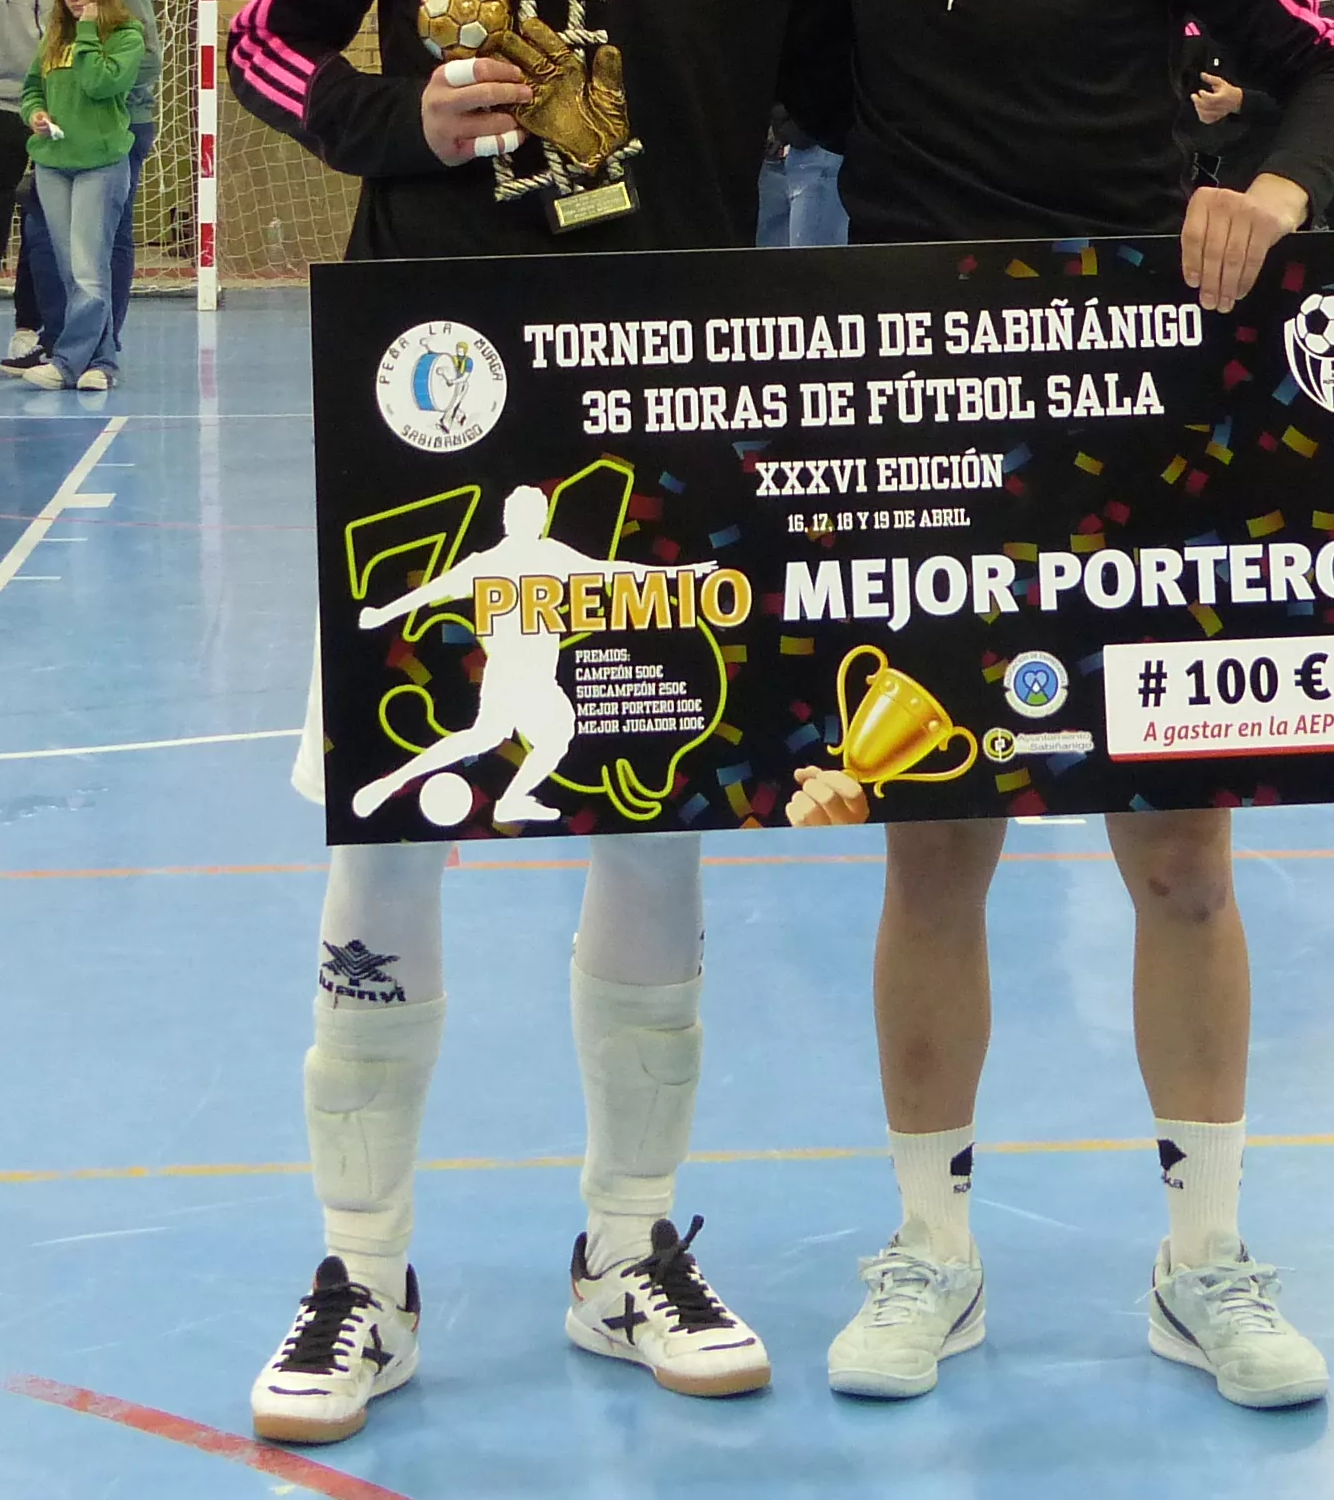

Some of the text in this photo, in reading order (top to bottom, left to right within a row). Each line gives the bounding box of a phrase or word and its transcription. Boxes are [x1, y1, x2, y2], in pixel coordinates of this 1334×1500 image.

[523, 297, 1203, 369] TORNEO CIUDAD DE SABIÑÁNIGO
[429, 323, 452, 335] LA
[474, 338, 504, 381] MURGA
[582, 370, 1165, 435] 36 HORAS DE FÚTBOL SALA
[755, 447, 1004, 497] XXXVI EDICIÓN
[788, 507, 971, 534] 16, 17, 18 Y 19 DE ABRIL
[473, 568, 752, 636] PREMIO
[783, 554, 1020, 632] MEJOR
[575, 649, 631, 663] PREMIOS:
[576, 664, 664, 681] CAMPEÓN 500€
[1138, 660, 1167, 708] #
[1185, 656, 1279, 706] 100
[1294, 652, 1332, 701] €
[576, 681, 687, 698] SUBCAMPEÓN 250€
[577, 699, 703, 716] MEJOR PORTERO 100€
[578, 716, 705, 734] MEJOR JUGADOR 100€
[1143, 721, 1157, 742] A
[1163, 720, 1233, 747] gastar
[1238, 721, 1262, 738] en
[1269, 716, 1288, 736] la
